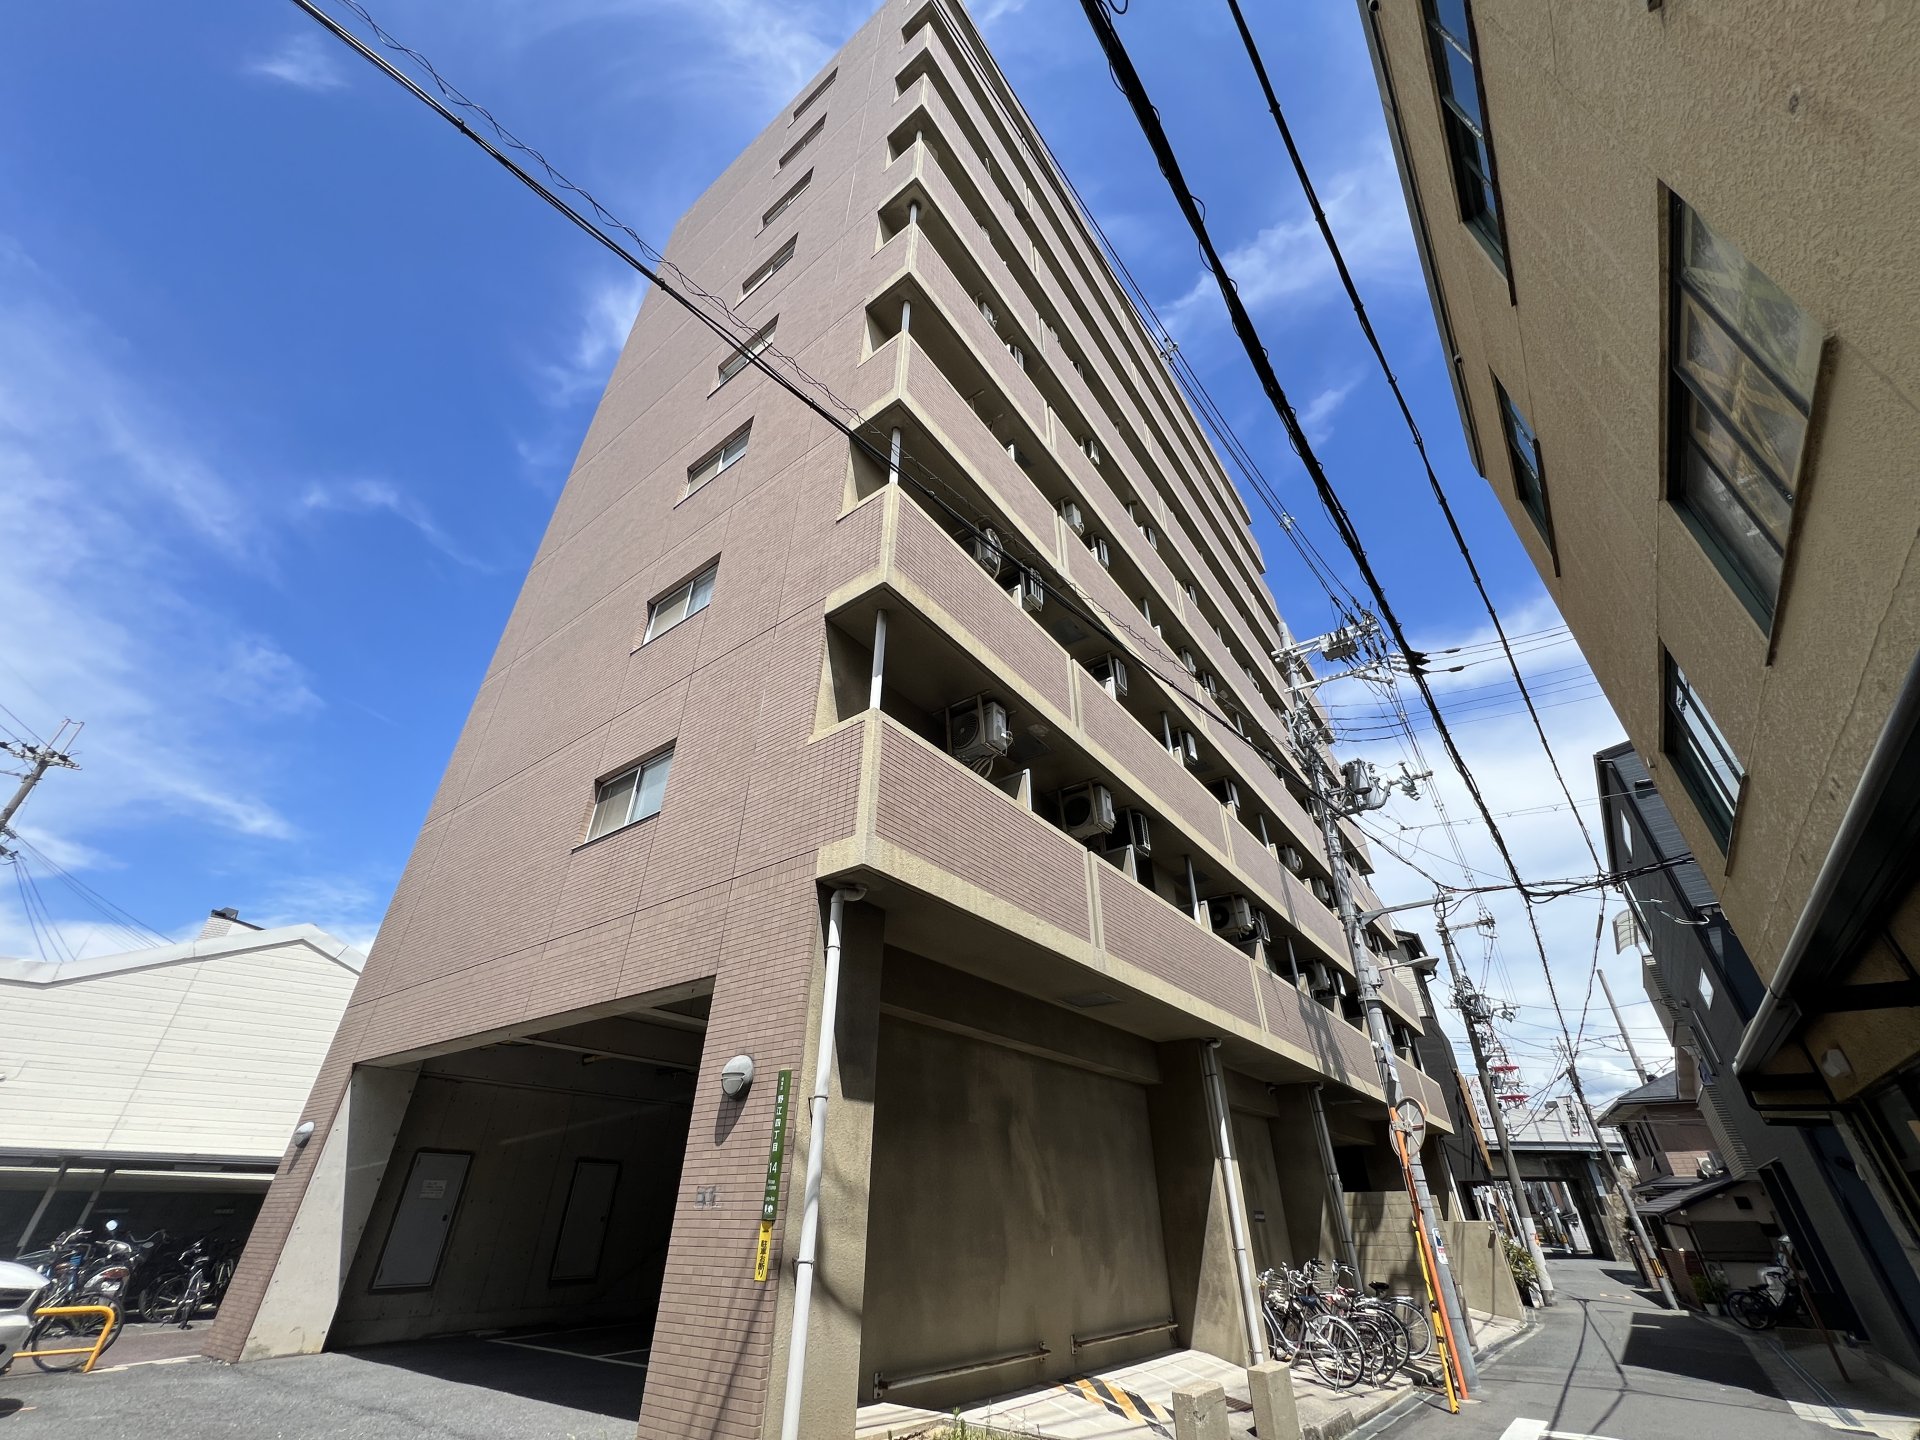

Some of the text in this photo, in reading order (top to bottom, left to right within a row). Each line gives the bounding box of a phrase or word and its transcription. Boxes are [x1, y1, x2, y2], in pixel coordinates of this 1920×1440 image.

[772, 1094, 784, 1151] 野江四丁目
[769, 1161, 778, 1173] 14
